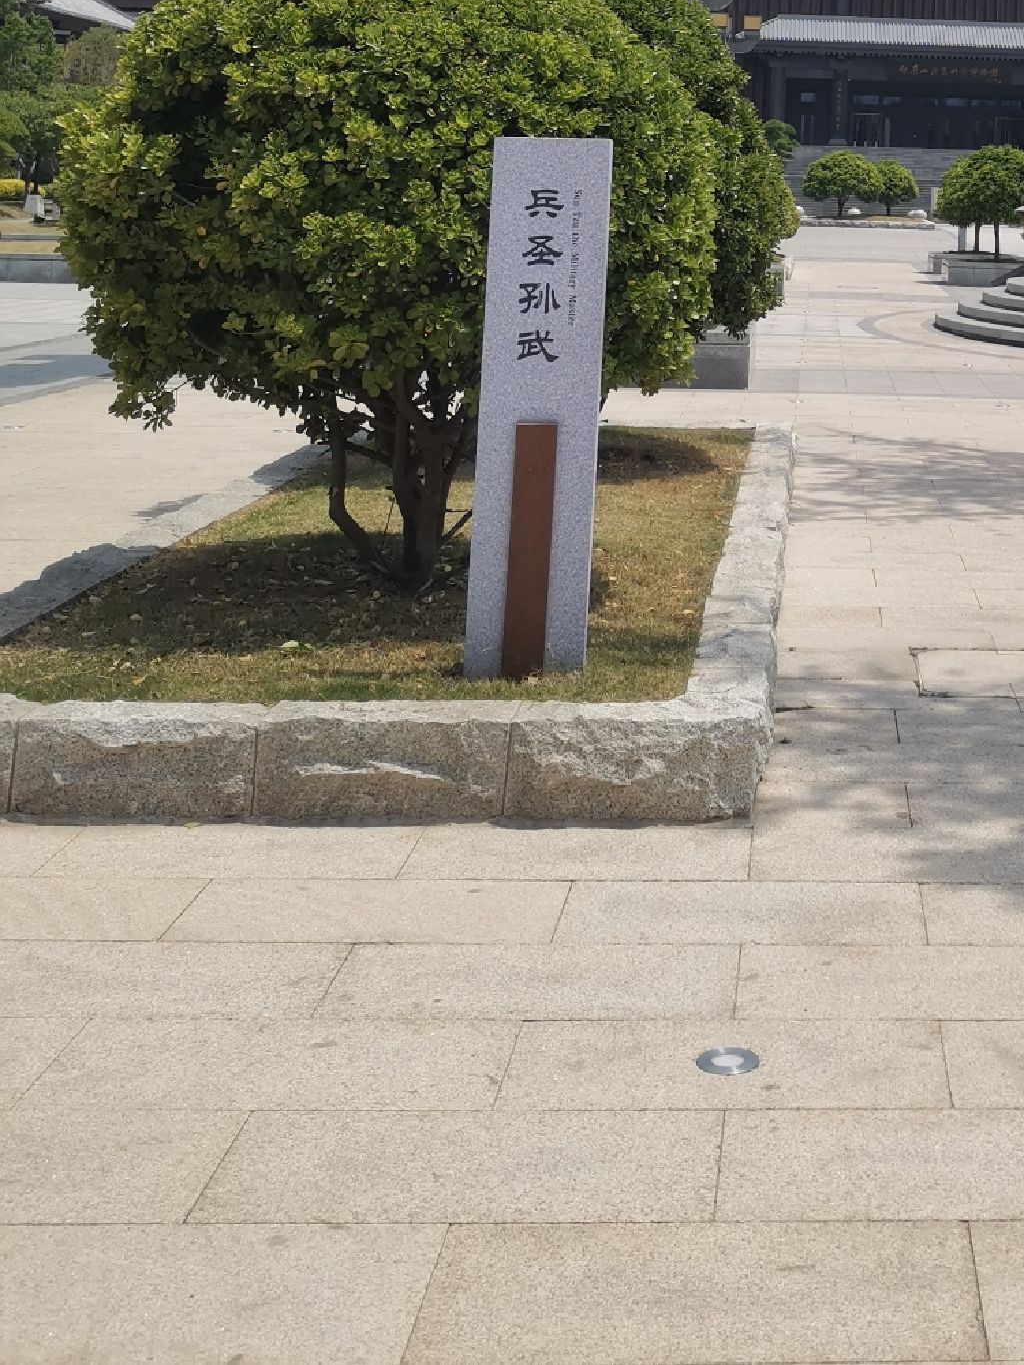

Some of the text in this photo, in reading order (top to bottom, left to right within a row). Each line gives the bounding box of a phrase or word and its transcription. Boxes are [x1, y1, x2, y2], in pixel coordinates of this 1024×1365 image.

[516, 189, 565, 363] 兵圣孙武
[567, 252, 580, 291] Military
[566, 294, 578, 329] Master
